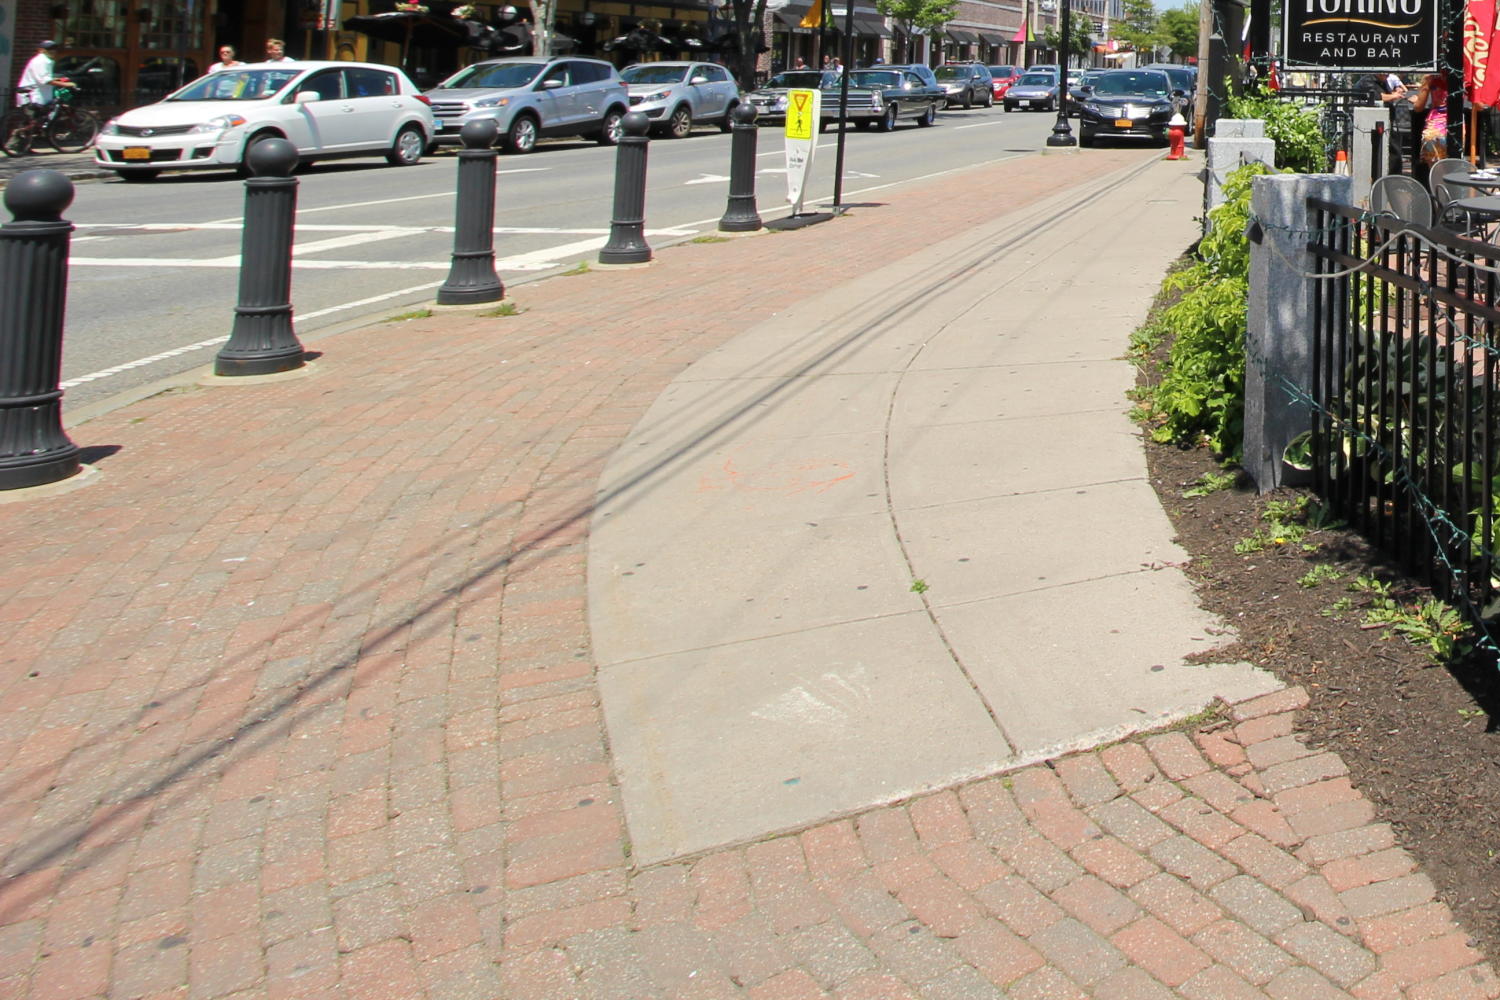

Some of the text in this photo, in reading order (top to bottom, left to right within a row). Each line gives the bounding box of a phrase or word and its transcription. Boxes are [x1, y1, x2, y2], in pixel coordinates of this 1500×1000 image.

[1302, 32, 1420, 44] RESTAURANT
[1320, 48, 1401, 58] AND BAR
